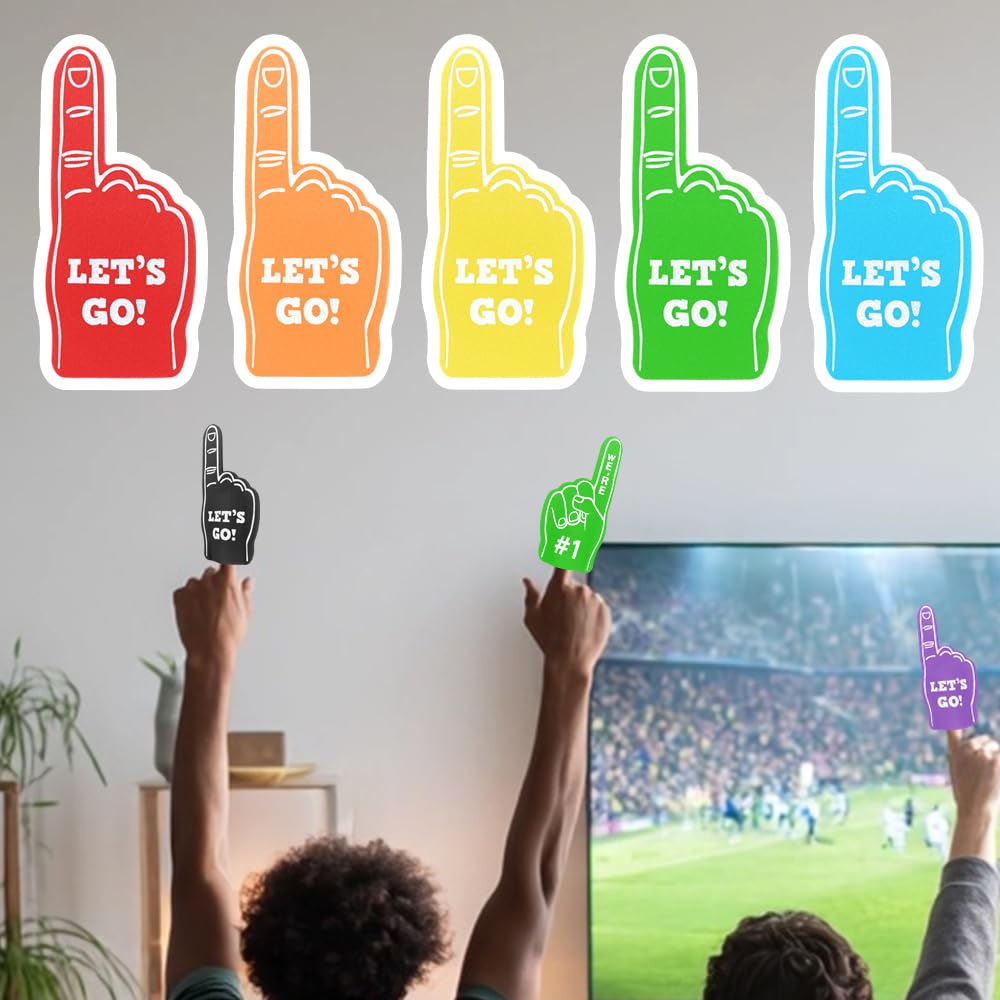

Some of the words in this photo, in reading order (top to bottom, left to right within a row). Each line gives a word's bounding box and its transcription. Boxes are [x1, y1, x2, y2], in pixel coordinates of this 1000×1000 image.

[67, 254, 166, 286] LET'S
[261, 254, 360, 285] LET'S
[455, 255, 554, 286] LET'S
[648, 255, 748, 287] LET'S
[841, 256, 941, 287] LET'S
[81, 297, 146, 326] GO!
[275, 296, 340, 325] GO!
[469, 297, 534, 326] GO!
[663, 298, 728, 328] GO!
[856, 299, 921, 328] GO!
[207, 509, 246, 524] LET'S
[212, 527, 237, 541] GO!
[553, 535, 582, 560] #1
[929, 677, 968, 693] LET'S
[937, 694, 963, 709] GO!
